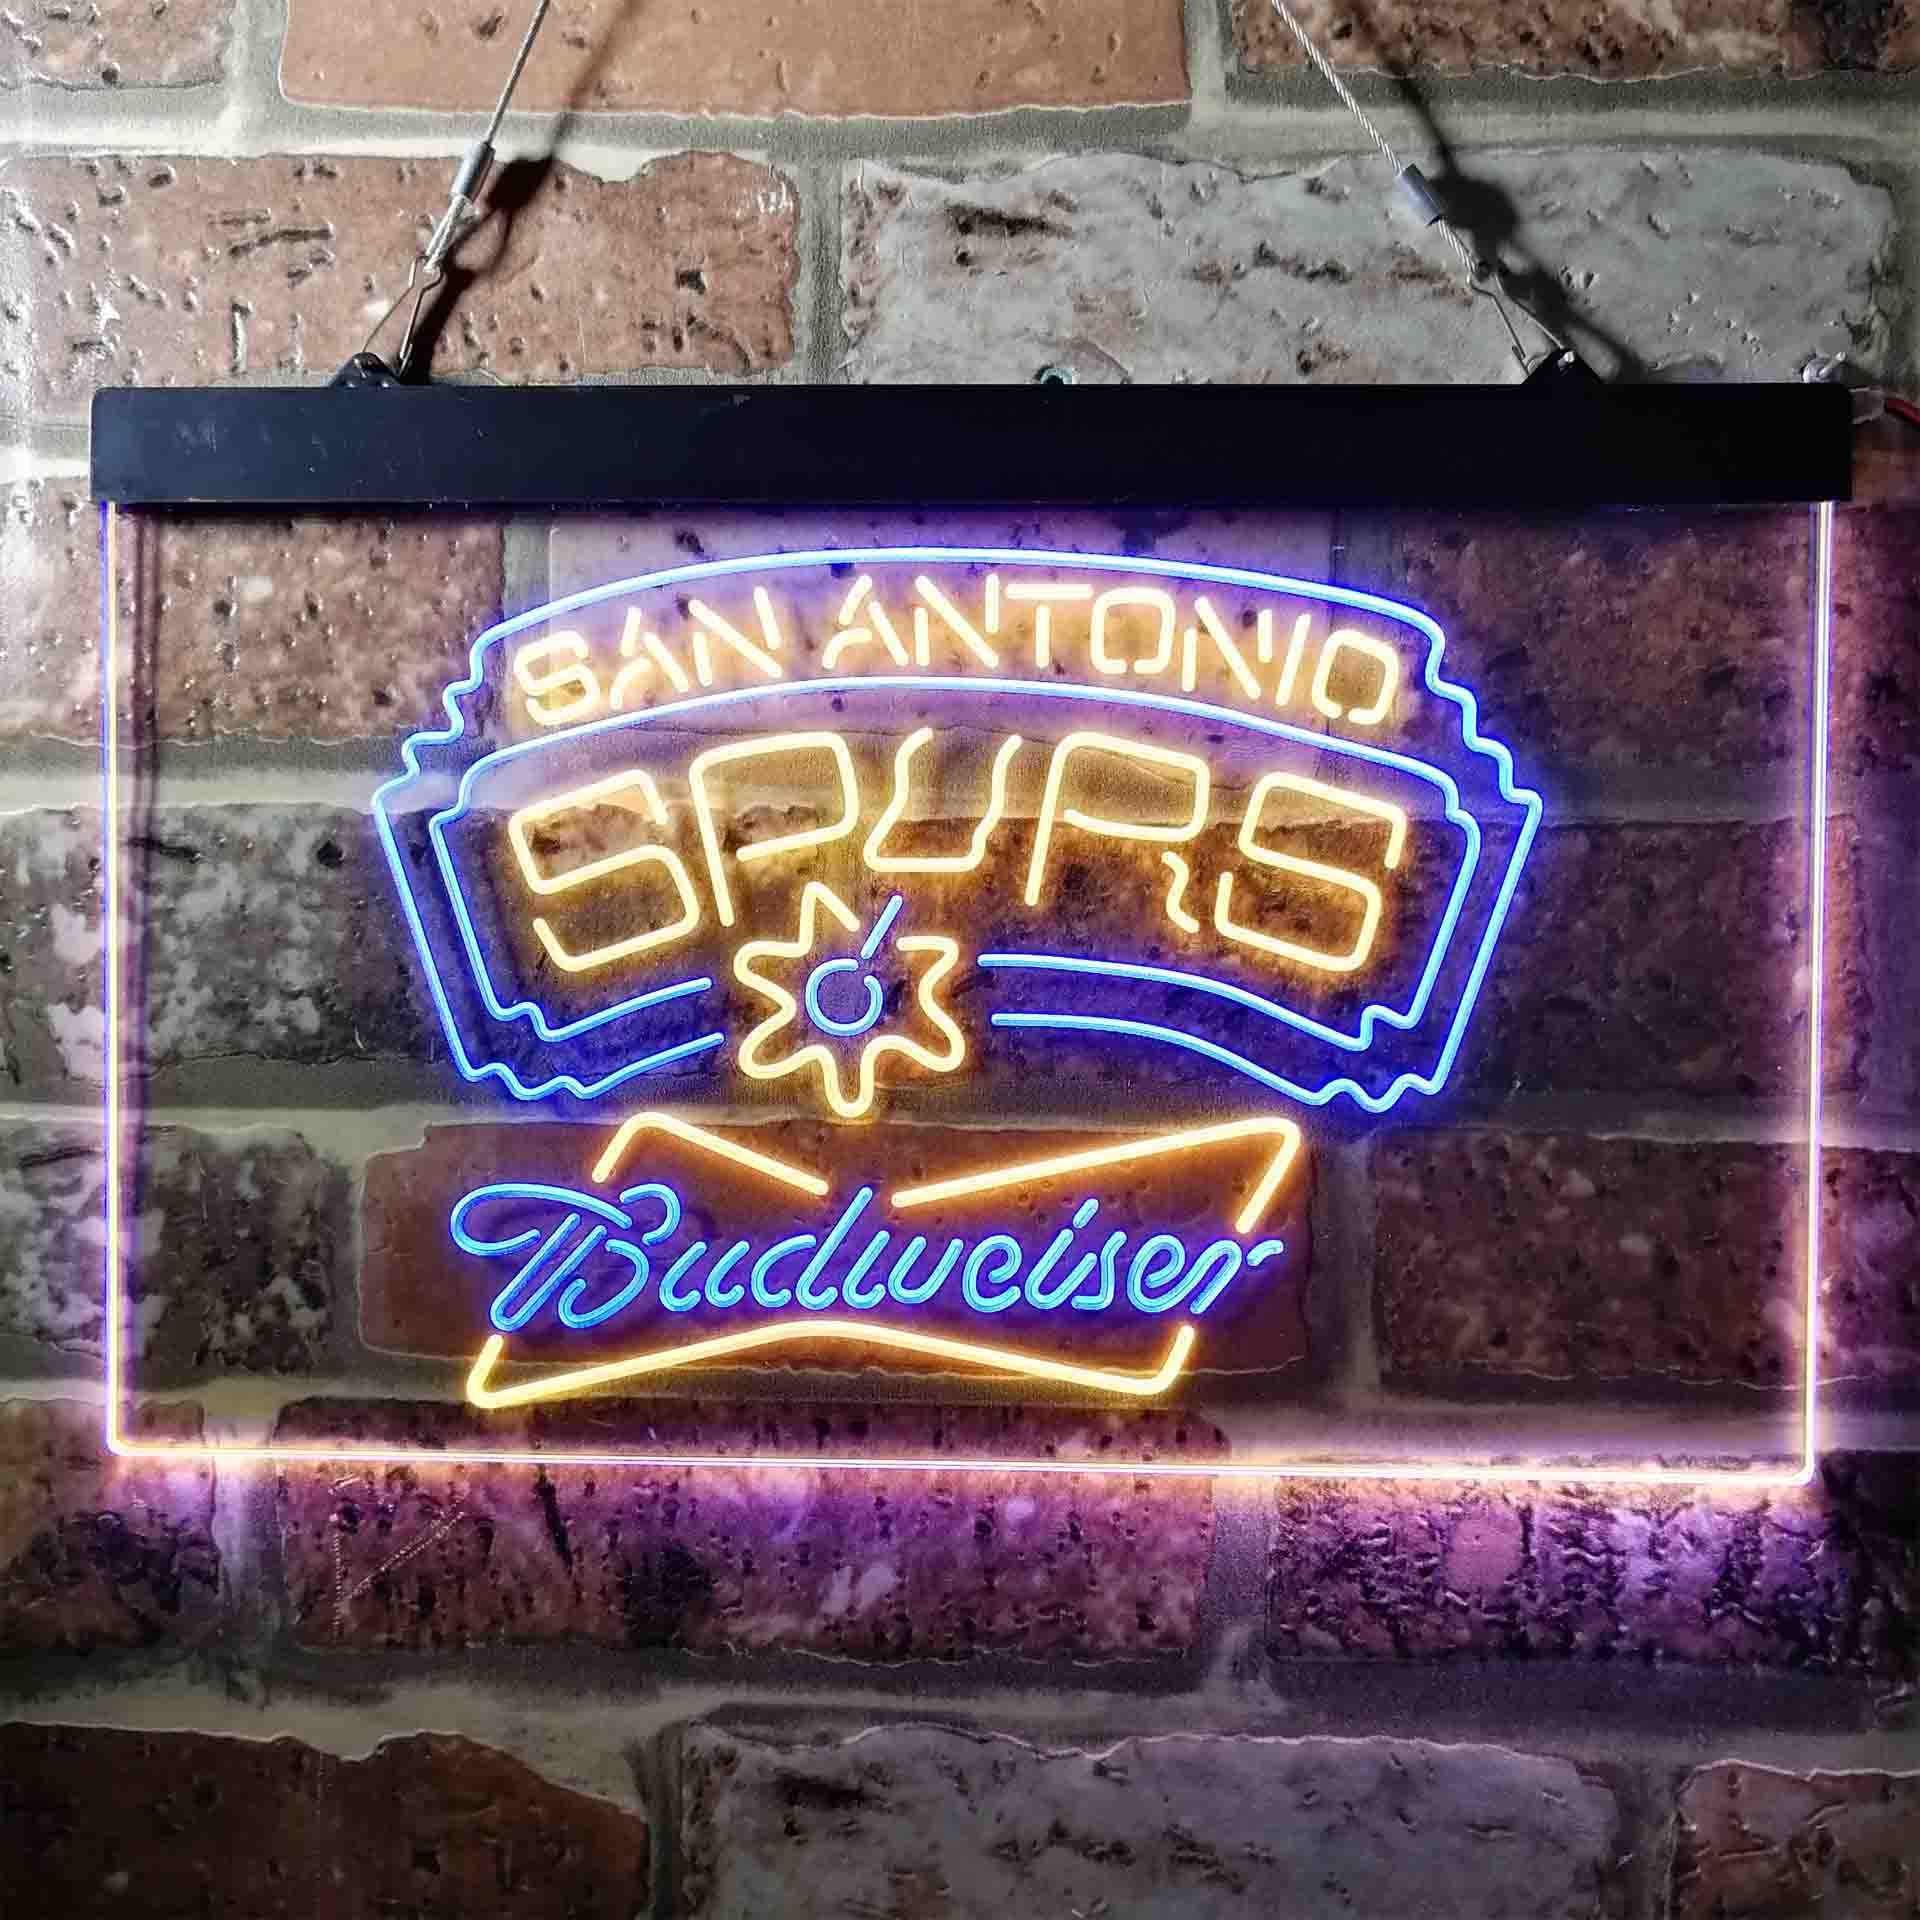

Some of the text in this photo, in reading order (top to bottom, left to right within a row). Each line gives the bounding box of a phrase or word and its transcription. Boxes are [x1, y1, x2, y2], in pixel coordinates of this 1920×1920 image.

[513, 573, 1400, 726] SAN ANTONIO
[507, 728, 1407, 973] SPURS
[450, 1183, 1284, 1331] Budweiser
